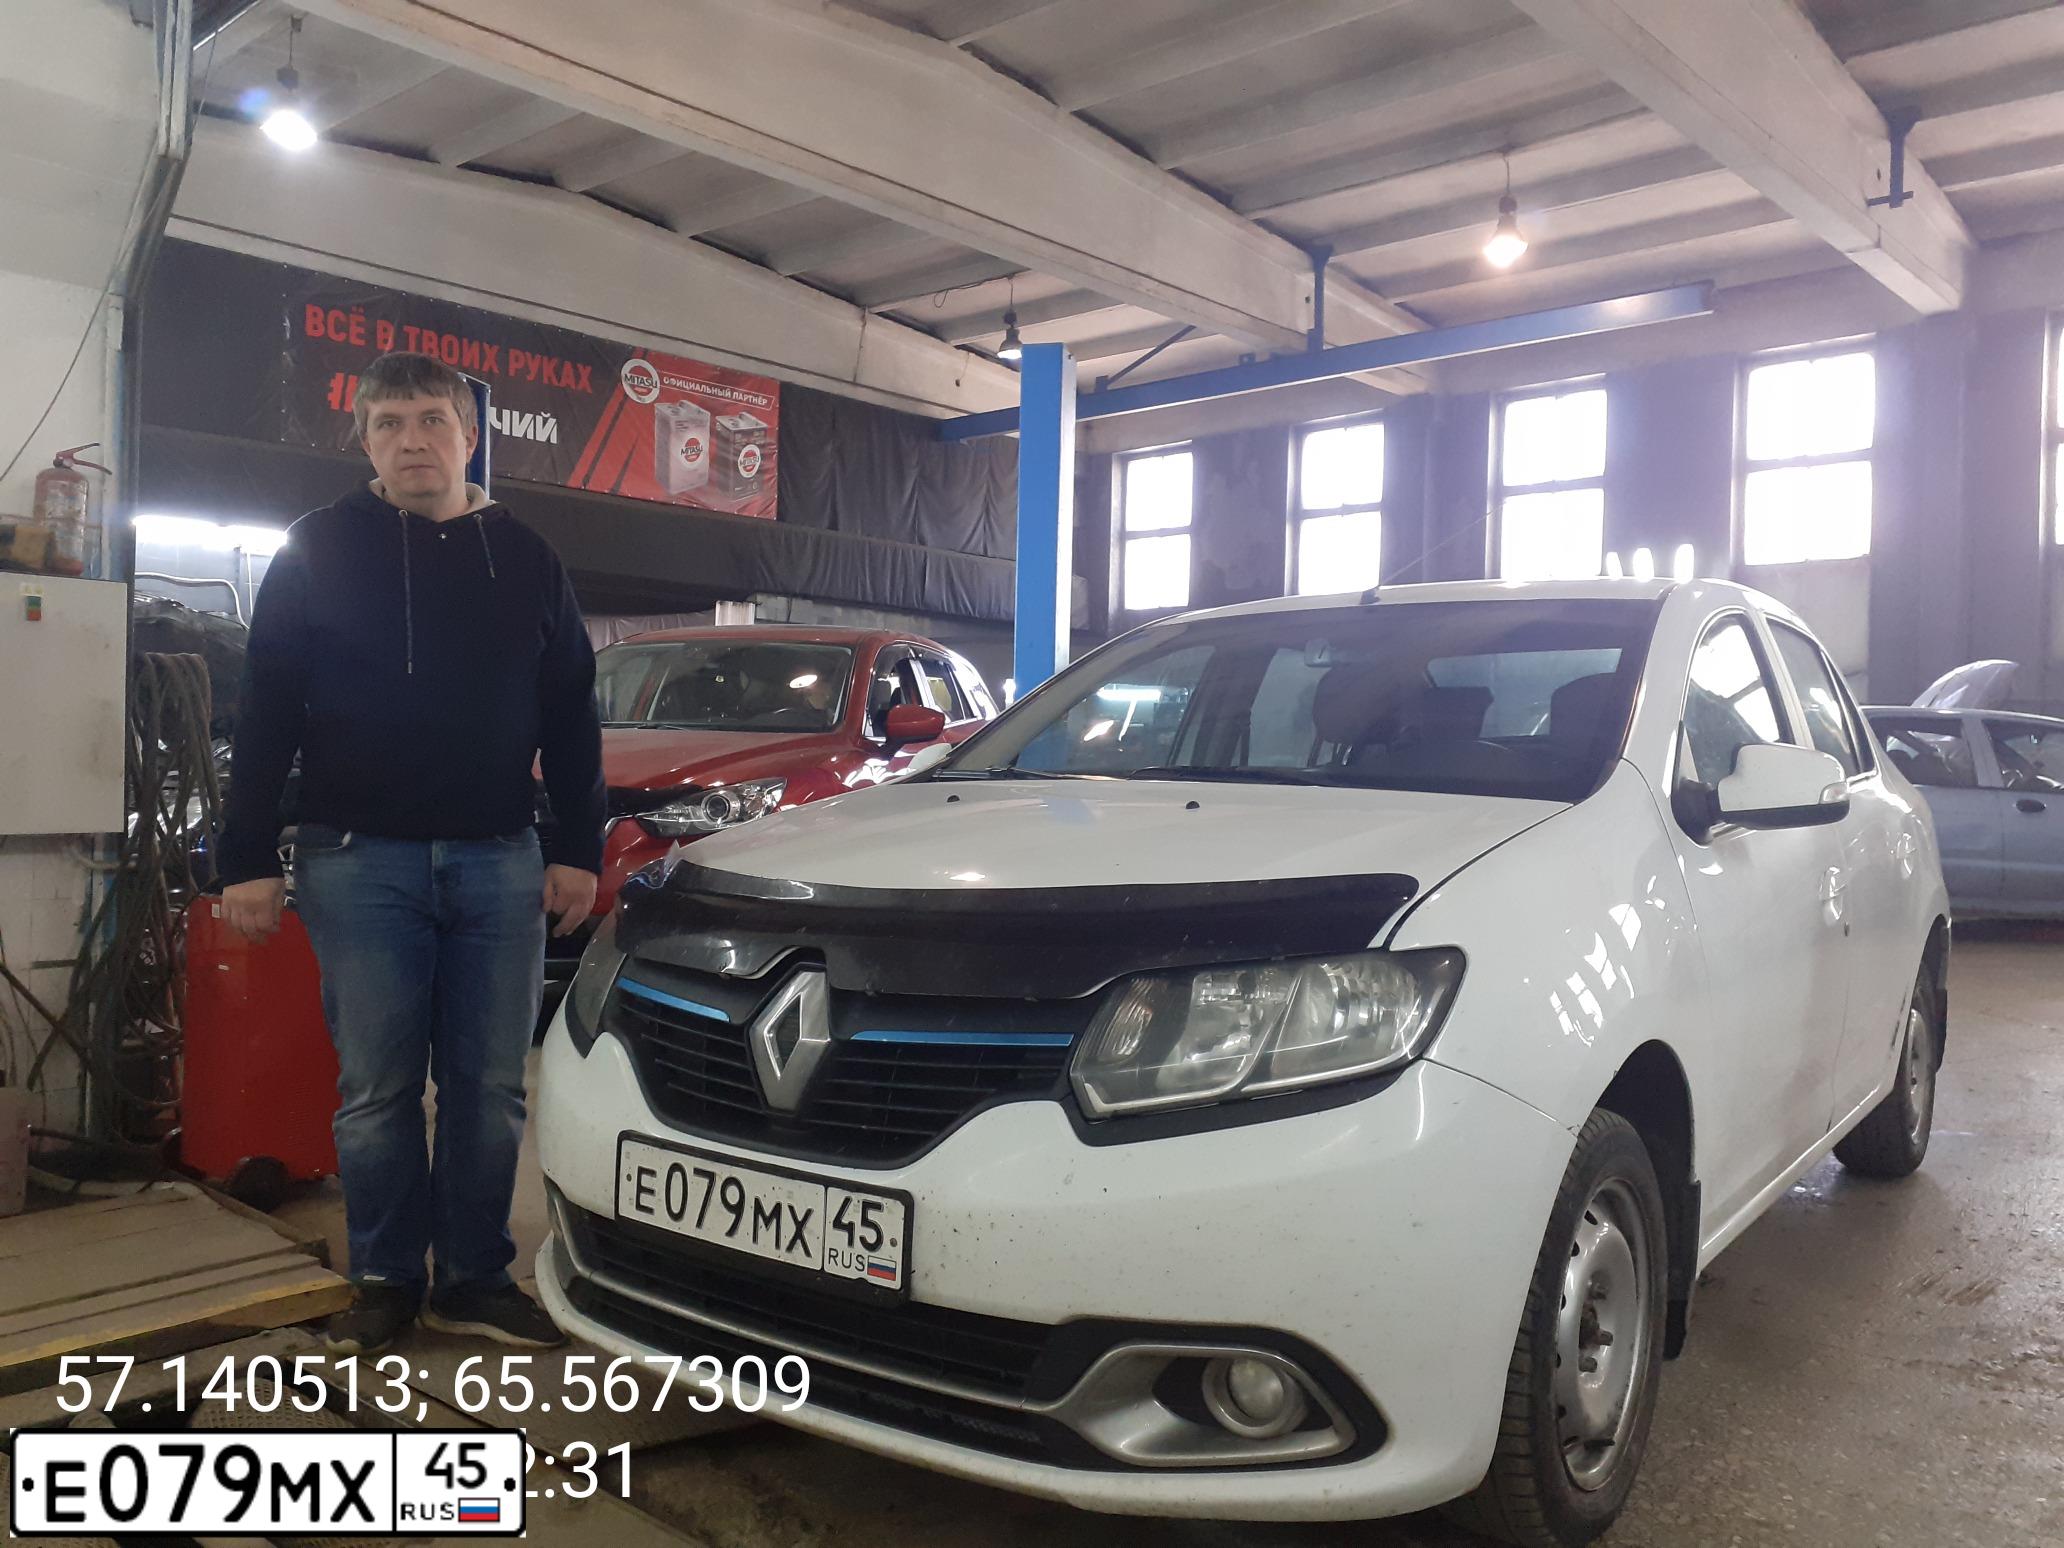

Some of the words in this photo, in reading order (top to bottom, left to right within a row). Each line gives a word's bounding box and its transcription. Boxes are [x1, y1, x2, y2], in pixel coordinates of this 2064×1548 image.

[305, 304, 366, 346] ВСЁ
[376, 319, 395, 351] В
[403, 325, 499, 374] ТВОИХ
[508, 348, 593, 393] РУКАХ
[624, 374, 658, 388] MITASU
[663, 376, 731, 398] ОФИЦИАЛЬНЫЙ
[732, 390, 768, 406] ПАРТНЁР
[832, 1195, 884, 1252] 45
[828, 1247, 866, 1273] RUS
